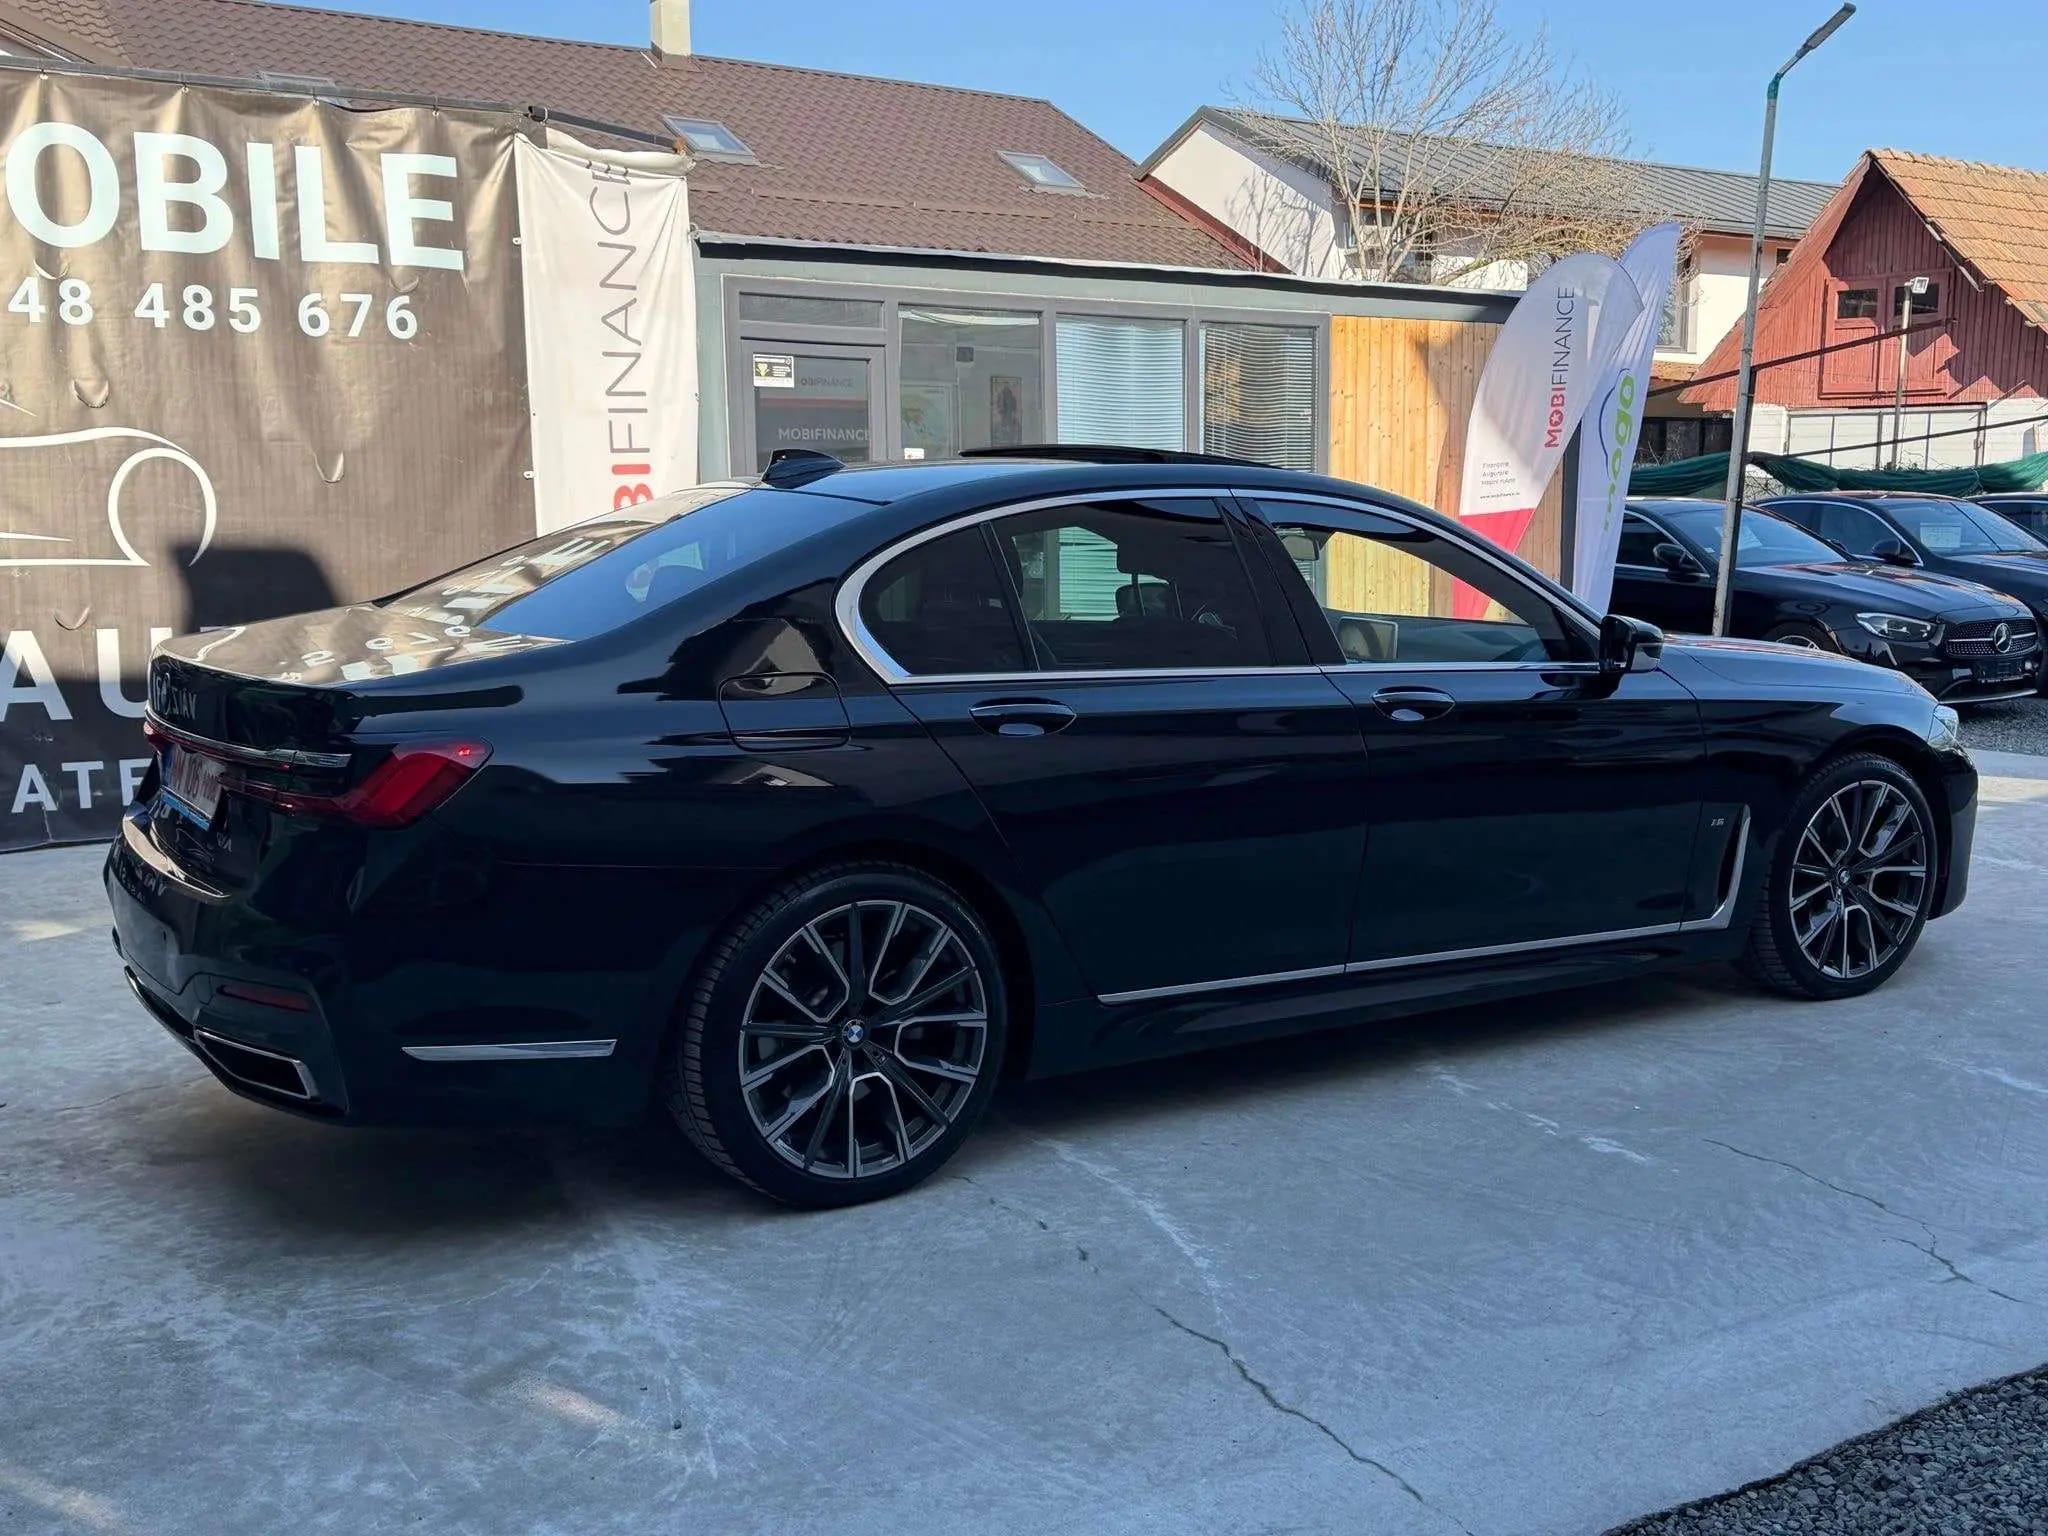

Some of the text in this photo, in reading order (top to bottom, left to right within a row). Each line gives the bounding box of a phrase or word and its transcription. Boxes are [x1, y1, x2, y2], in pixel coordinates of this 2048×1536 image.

[5, 121, 464, 271] OBILE
[8, 276, 419, 340] 48 485 676
[1544, 286, 1576, 448] MOBIFINANCE
[0, 626, 221, 722] AU
